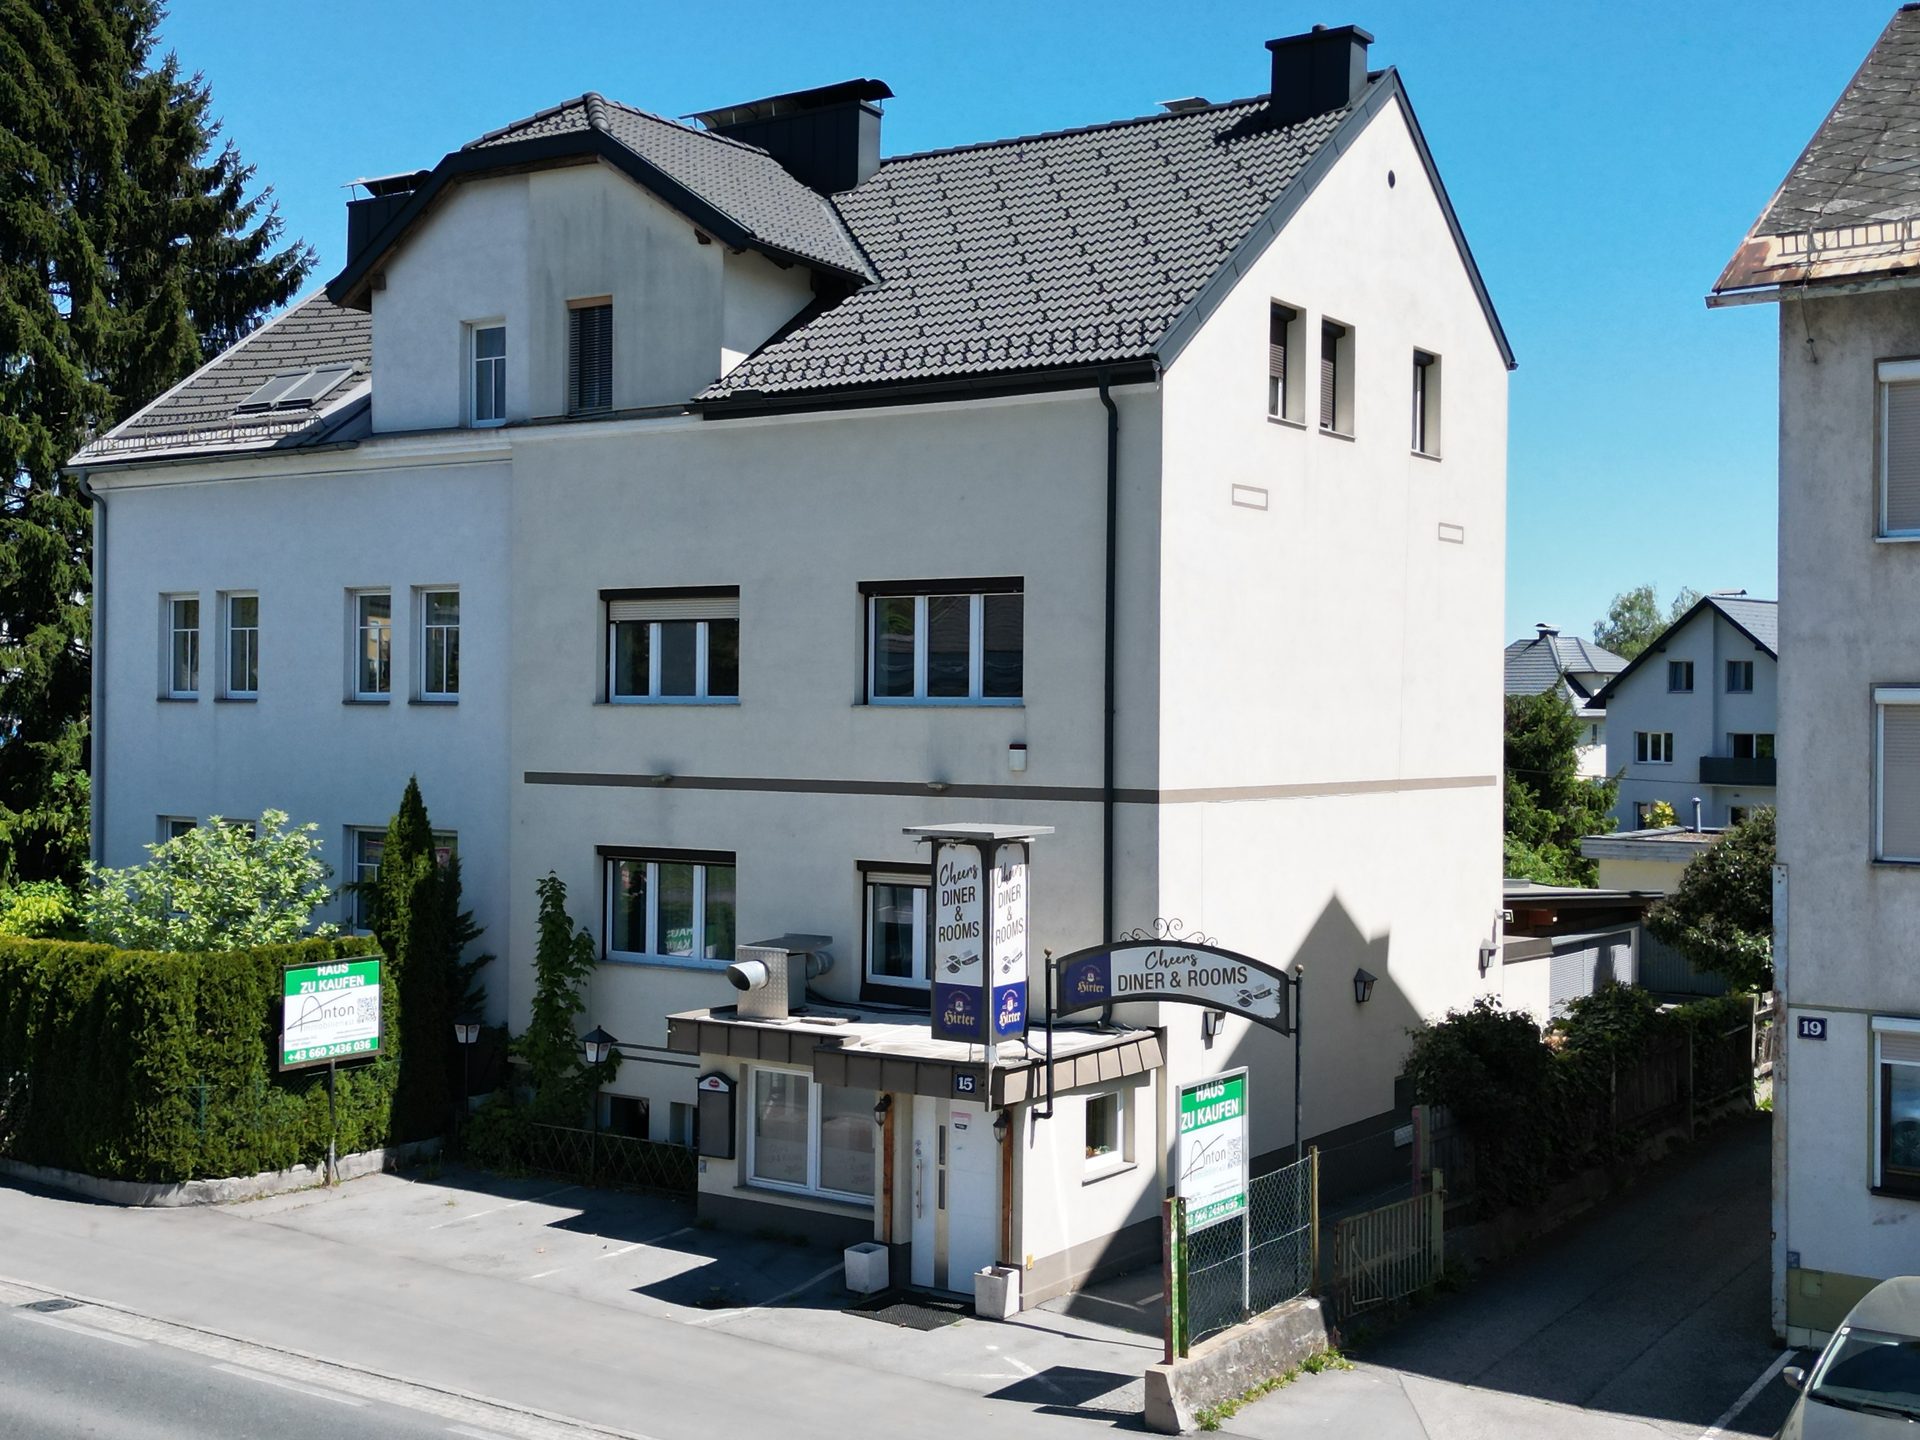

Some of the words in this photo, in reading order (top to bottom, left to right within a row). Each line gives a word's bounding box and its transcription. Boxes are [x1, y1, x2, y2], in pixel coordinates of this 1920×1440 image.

[940, 861, 978, 886] Cheers
[997, 862, 1022, 888] Cheers
[942, 886, 975, 906] DINER
[998, 884, 1021, 908] DINER
[954, 905, 963, 922] &
[1006, 905, 1012, 921] &
[938, 921, 979, 943] ROOMS
[995, 917, 1023, 946] ROOMS
[317, 963, 349, 976] HAUS
[1145, 949, 1199, 970] Cheers
[300, 981, 316, 993] ZU
[318, 975, 365, 992] KAUFEN
[1077, 981, 1104, 993] Hirter
[1118, 972, 1165, 992] DINER
[1170, 971, 1181, 988] &
[1188, 966, 1248, 987] ROOMS
[286, 991, 355, 1032] Anton
[943, 1010, 975, 1026] Hirter
[1802, 1021, 1822, 1036] 19
[288, 1049, 306, 1061] +43
[309, 1047, 327, 1058] 660
[329, 1043, 352, 1055] 2436
[353, 1039, 371, 1050] 036
[958, 1076, 973, 1091] 15
[1196, 1080, 1225, 1103] HAUS
[1181, 1110, 1195, 1131] ZU
[1197, 1097, 1239, 1125] KAUFEN
[1181, 1133, 1226, 1182] Anton
